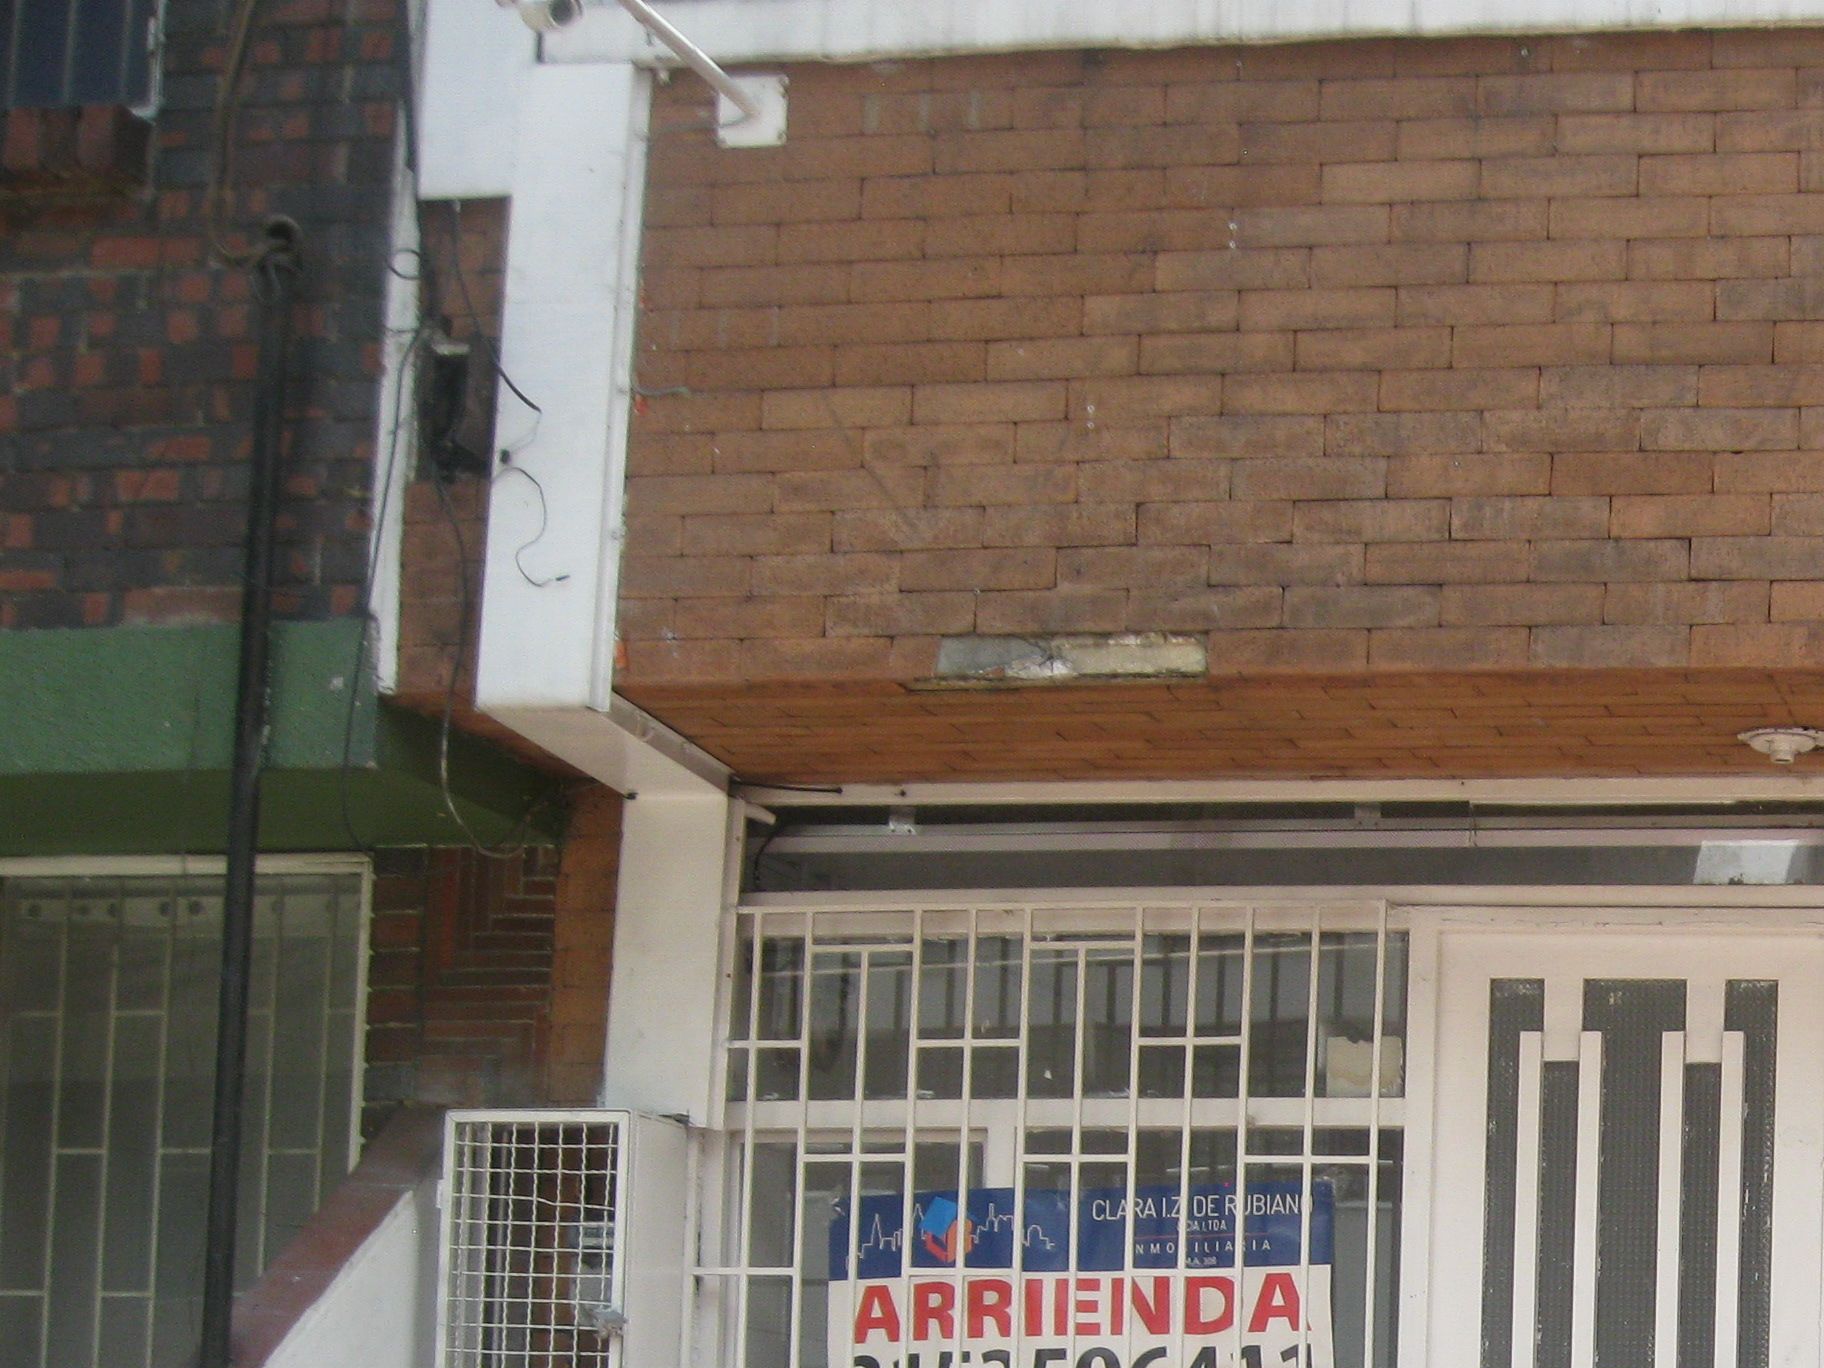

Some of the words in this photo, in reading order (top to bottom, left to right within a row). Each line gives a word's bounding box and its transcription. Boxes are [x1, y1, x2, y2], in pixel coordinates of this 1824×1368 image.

[1092, 1197, 1157, 1221] CLARA
[1193, 1195, 1220, 1217] DE
[1128, 1239, 1271, 1256] NMOILIAIA
[854, 1273, 1311, 1344] ARRIENDA
